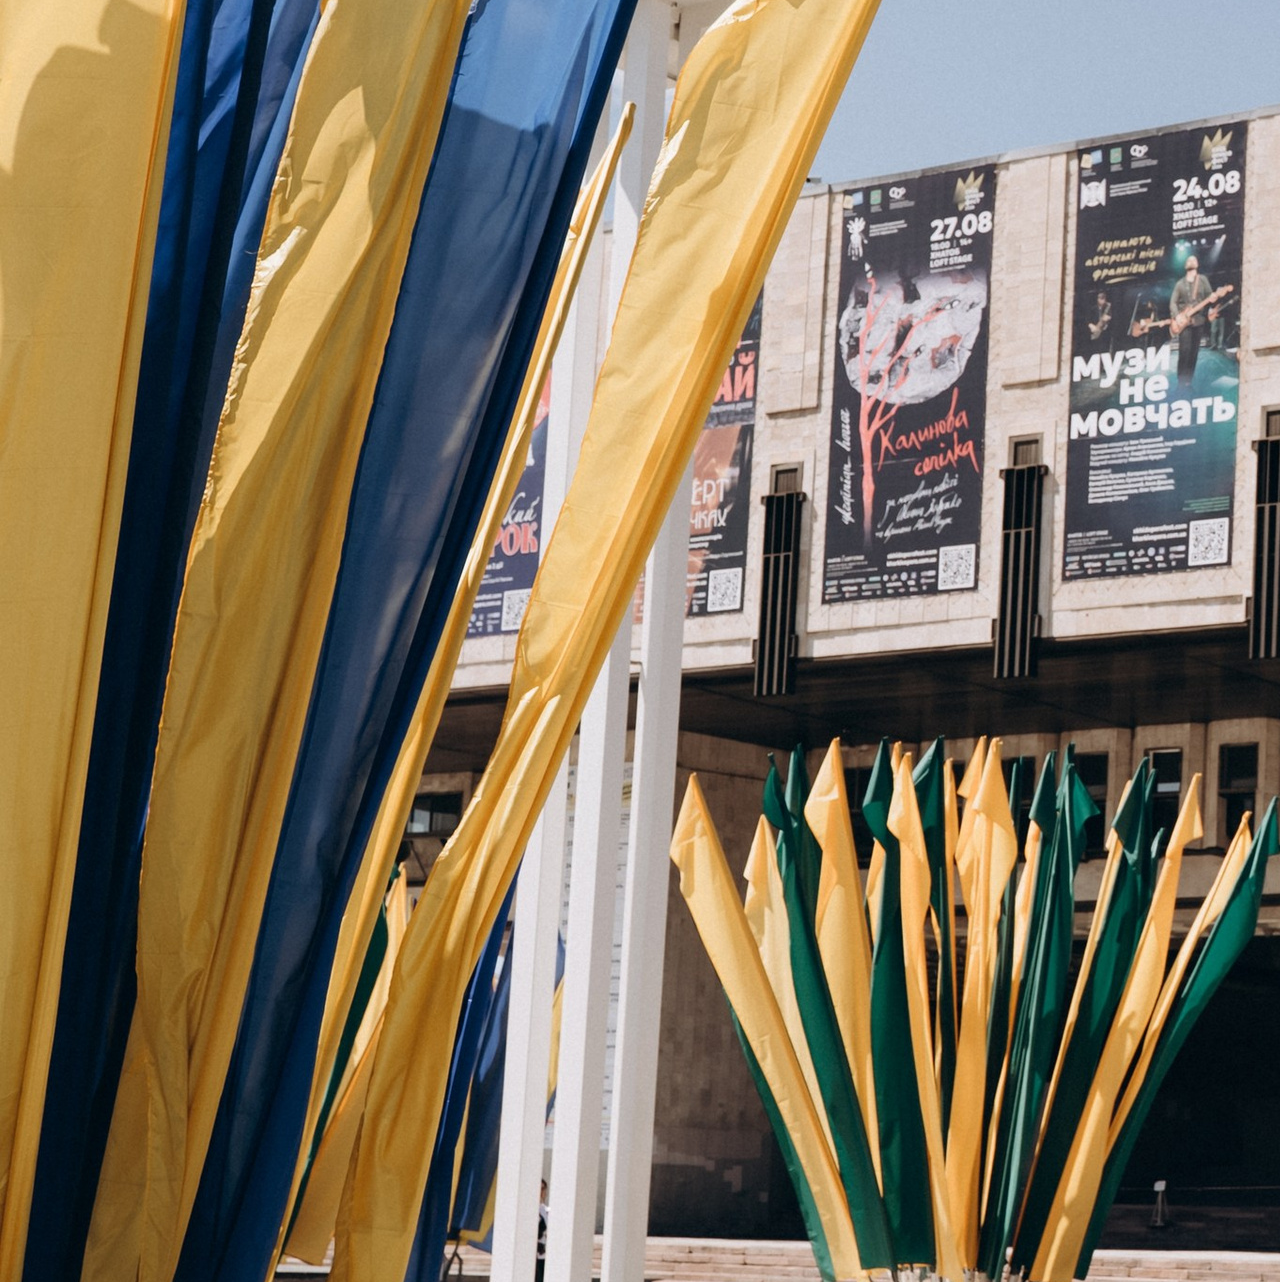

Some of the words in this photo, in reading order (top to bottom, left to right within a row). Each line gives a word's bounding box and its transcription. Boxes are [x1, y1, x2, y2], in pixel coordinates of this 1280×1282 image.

[1172, 170, 1241, 202] 24.08
[930, 211, 993, 242] 27.08
[1119, 374, 1170, 405] не
